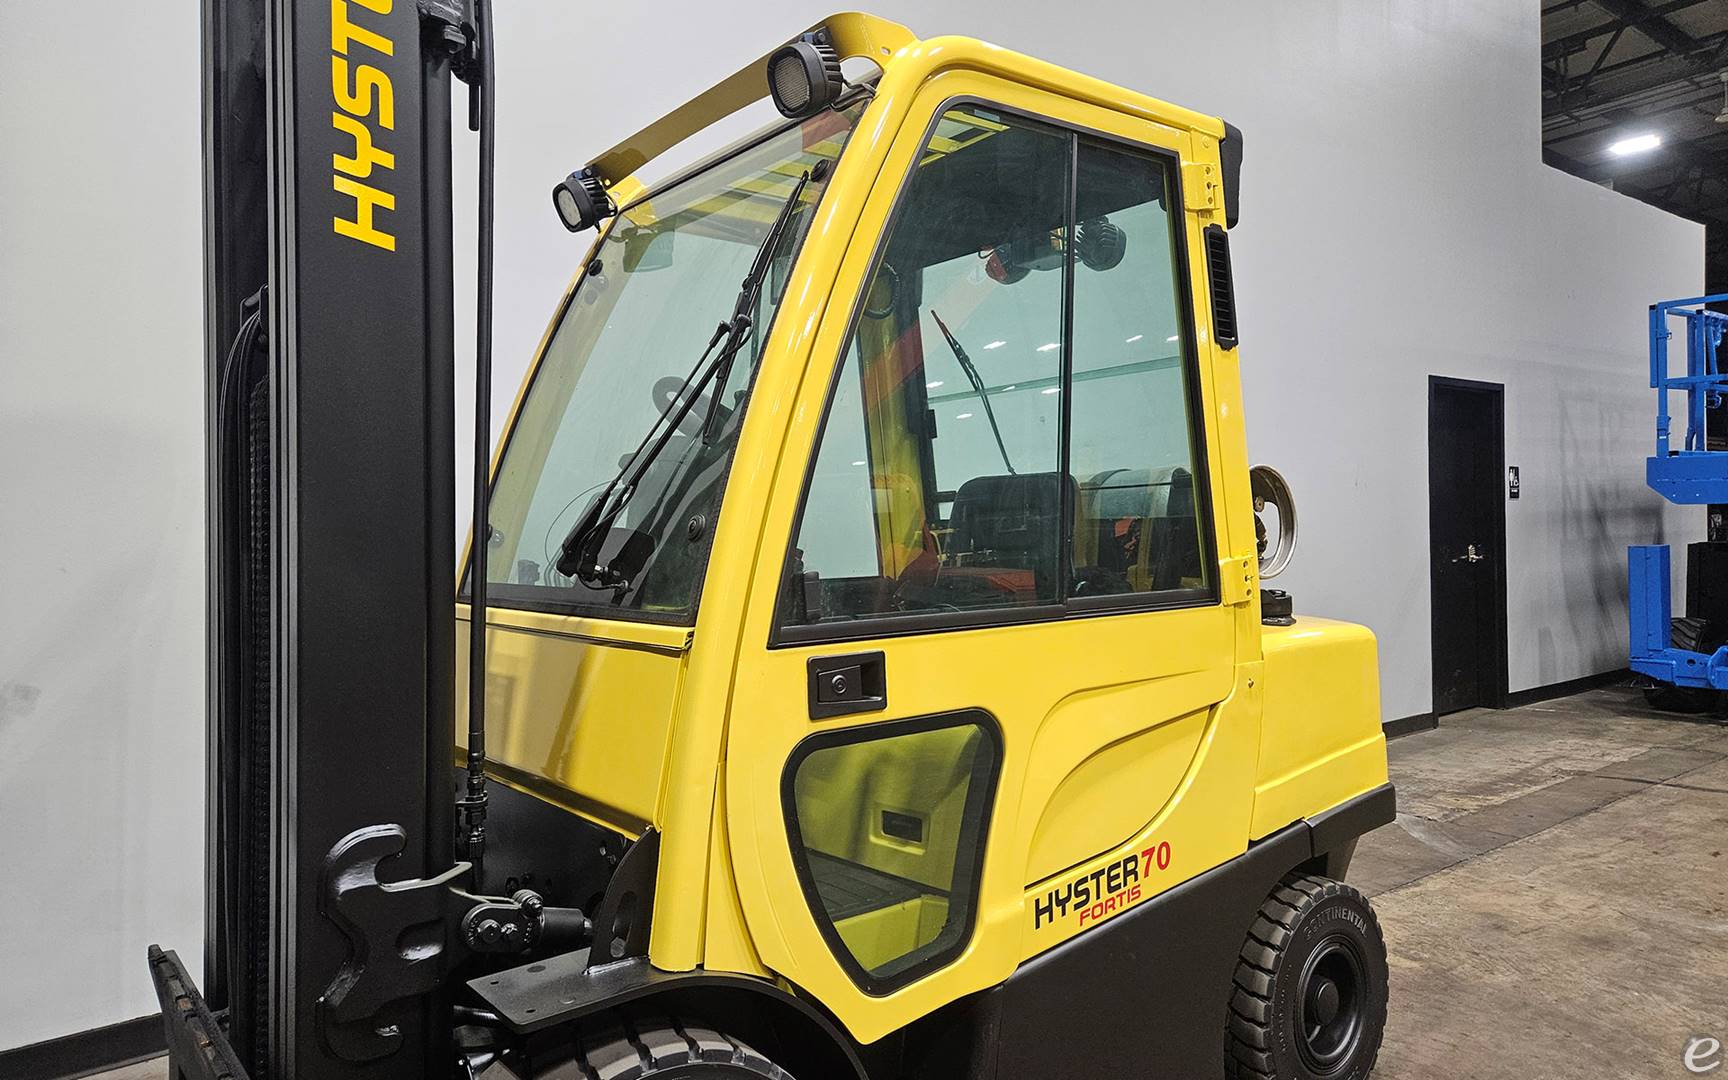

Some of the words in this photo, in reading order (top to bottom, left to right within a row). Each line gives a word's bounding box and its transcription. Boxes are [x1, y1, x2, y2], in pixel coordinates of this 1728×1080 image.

[331, 0, 395, 252] HYST
[1034, 854, 1139, 930] HYSTER
[1141, 841, 1171, 879] 70
[1079, 884, 1141, 927] FORTIS
